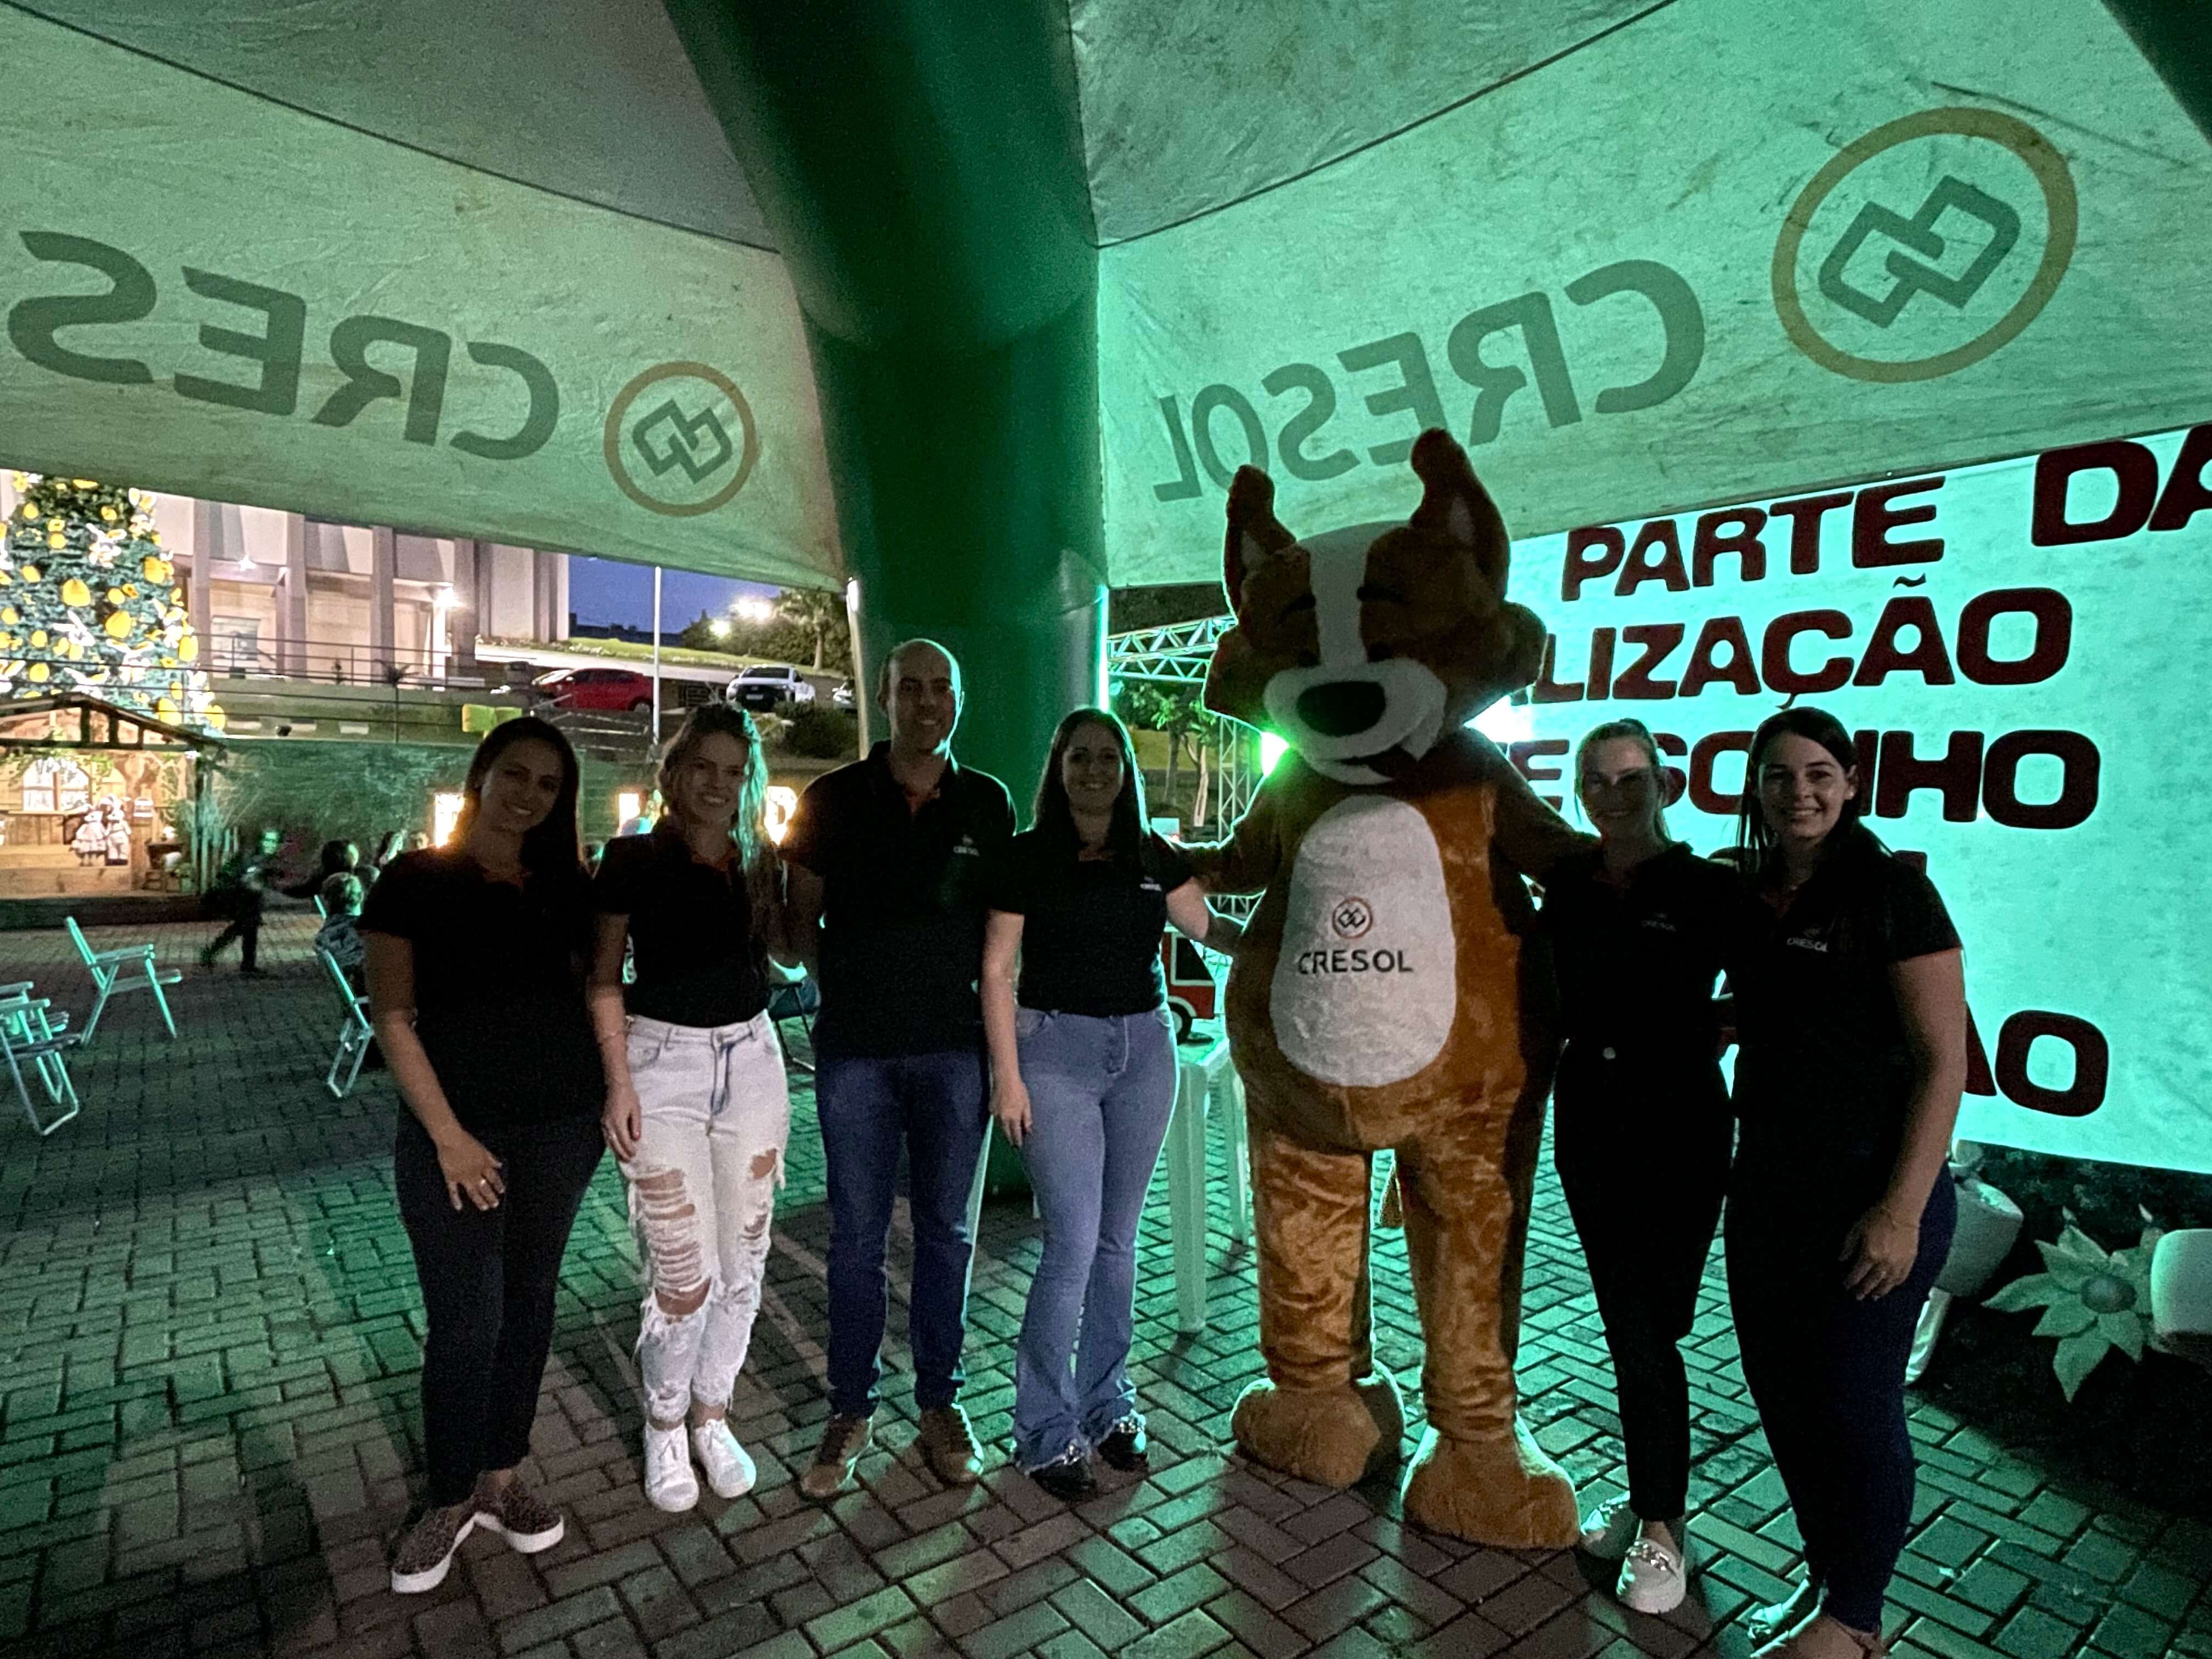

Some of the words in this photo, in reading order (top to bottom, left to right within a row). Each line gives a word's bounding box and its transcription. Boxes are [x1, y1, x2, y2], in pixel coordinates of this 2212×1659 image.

[1561, 476, 1946, 601] PARTE
[1510, 573, 2073, 709] LIZAÇÃO
[1298, 949, 1413, 974] CRESOL
